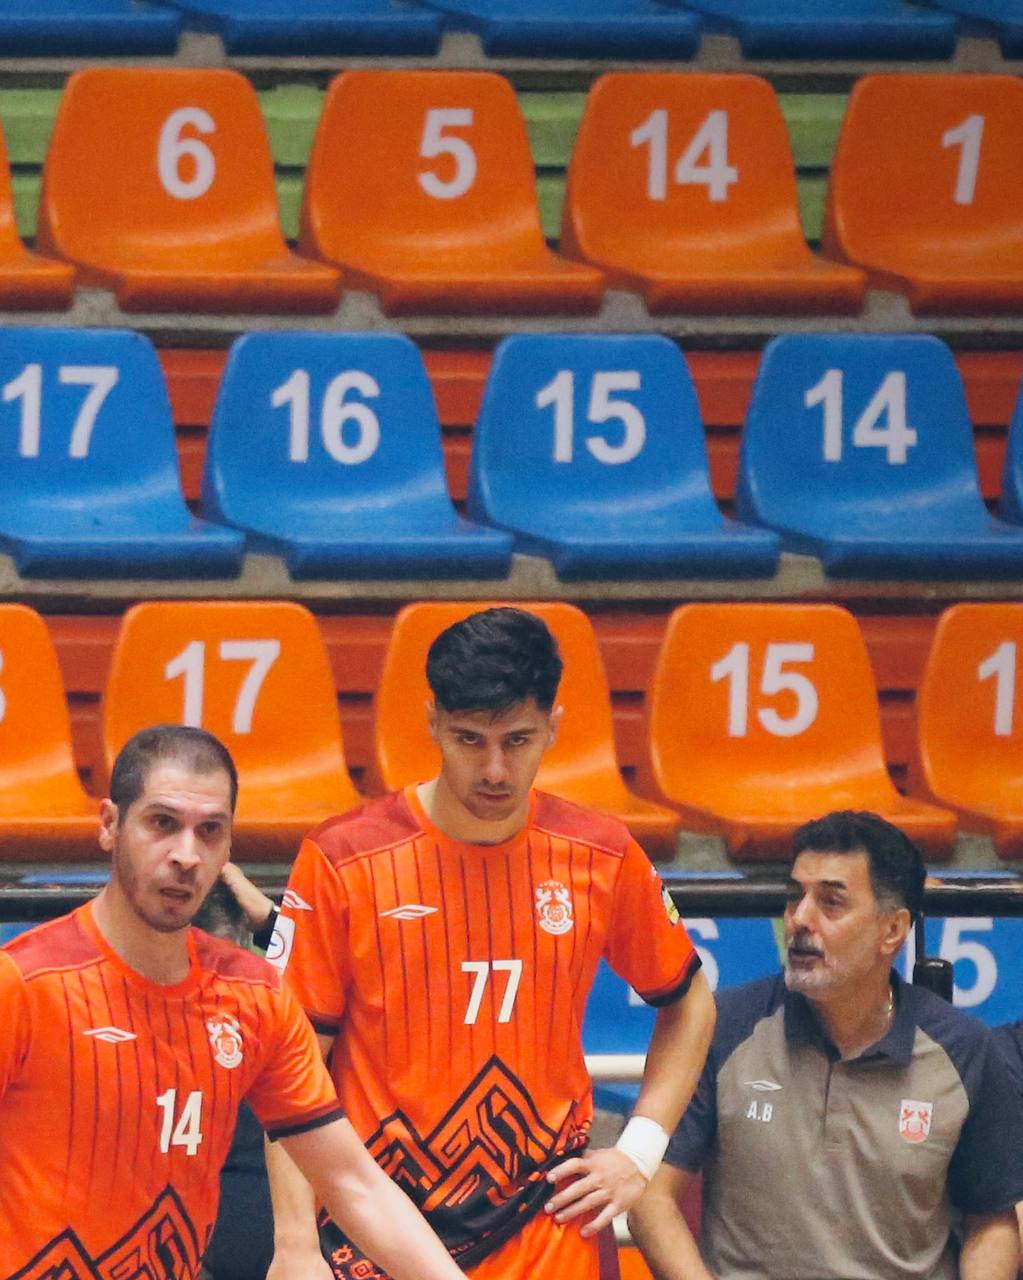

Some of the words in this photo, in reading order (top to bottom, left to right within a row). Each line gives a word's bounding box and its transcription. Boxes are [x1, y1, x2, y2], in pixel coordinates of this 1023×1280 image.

[157, 107, 216, 200] 6
[418, 108, 477, 200] 5
[630, 109, 738, 201] 14
[942, 115, 985, 205] 1
[2, 363, 119, 459] 17
[271, 369, 380, 465] 16
[535, 370, 646, 465] 15
[804, 368, 918, 465] 14
[164, 639, 281, 734] 17
[710, 643, 819, 738] 15
[977, 641, 1017, 736] 1
[460, 959, 523, 1025] 77
[156, 1088, 204, 1157] 14
[747, 1101, 773, 1122] A.B
